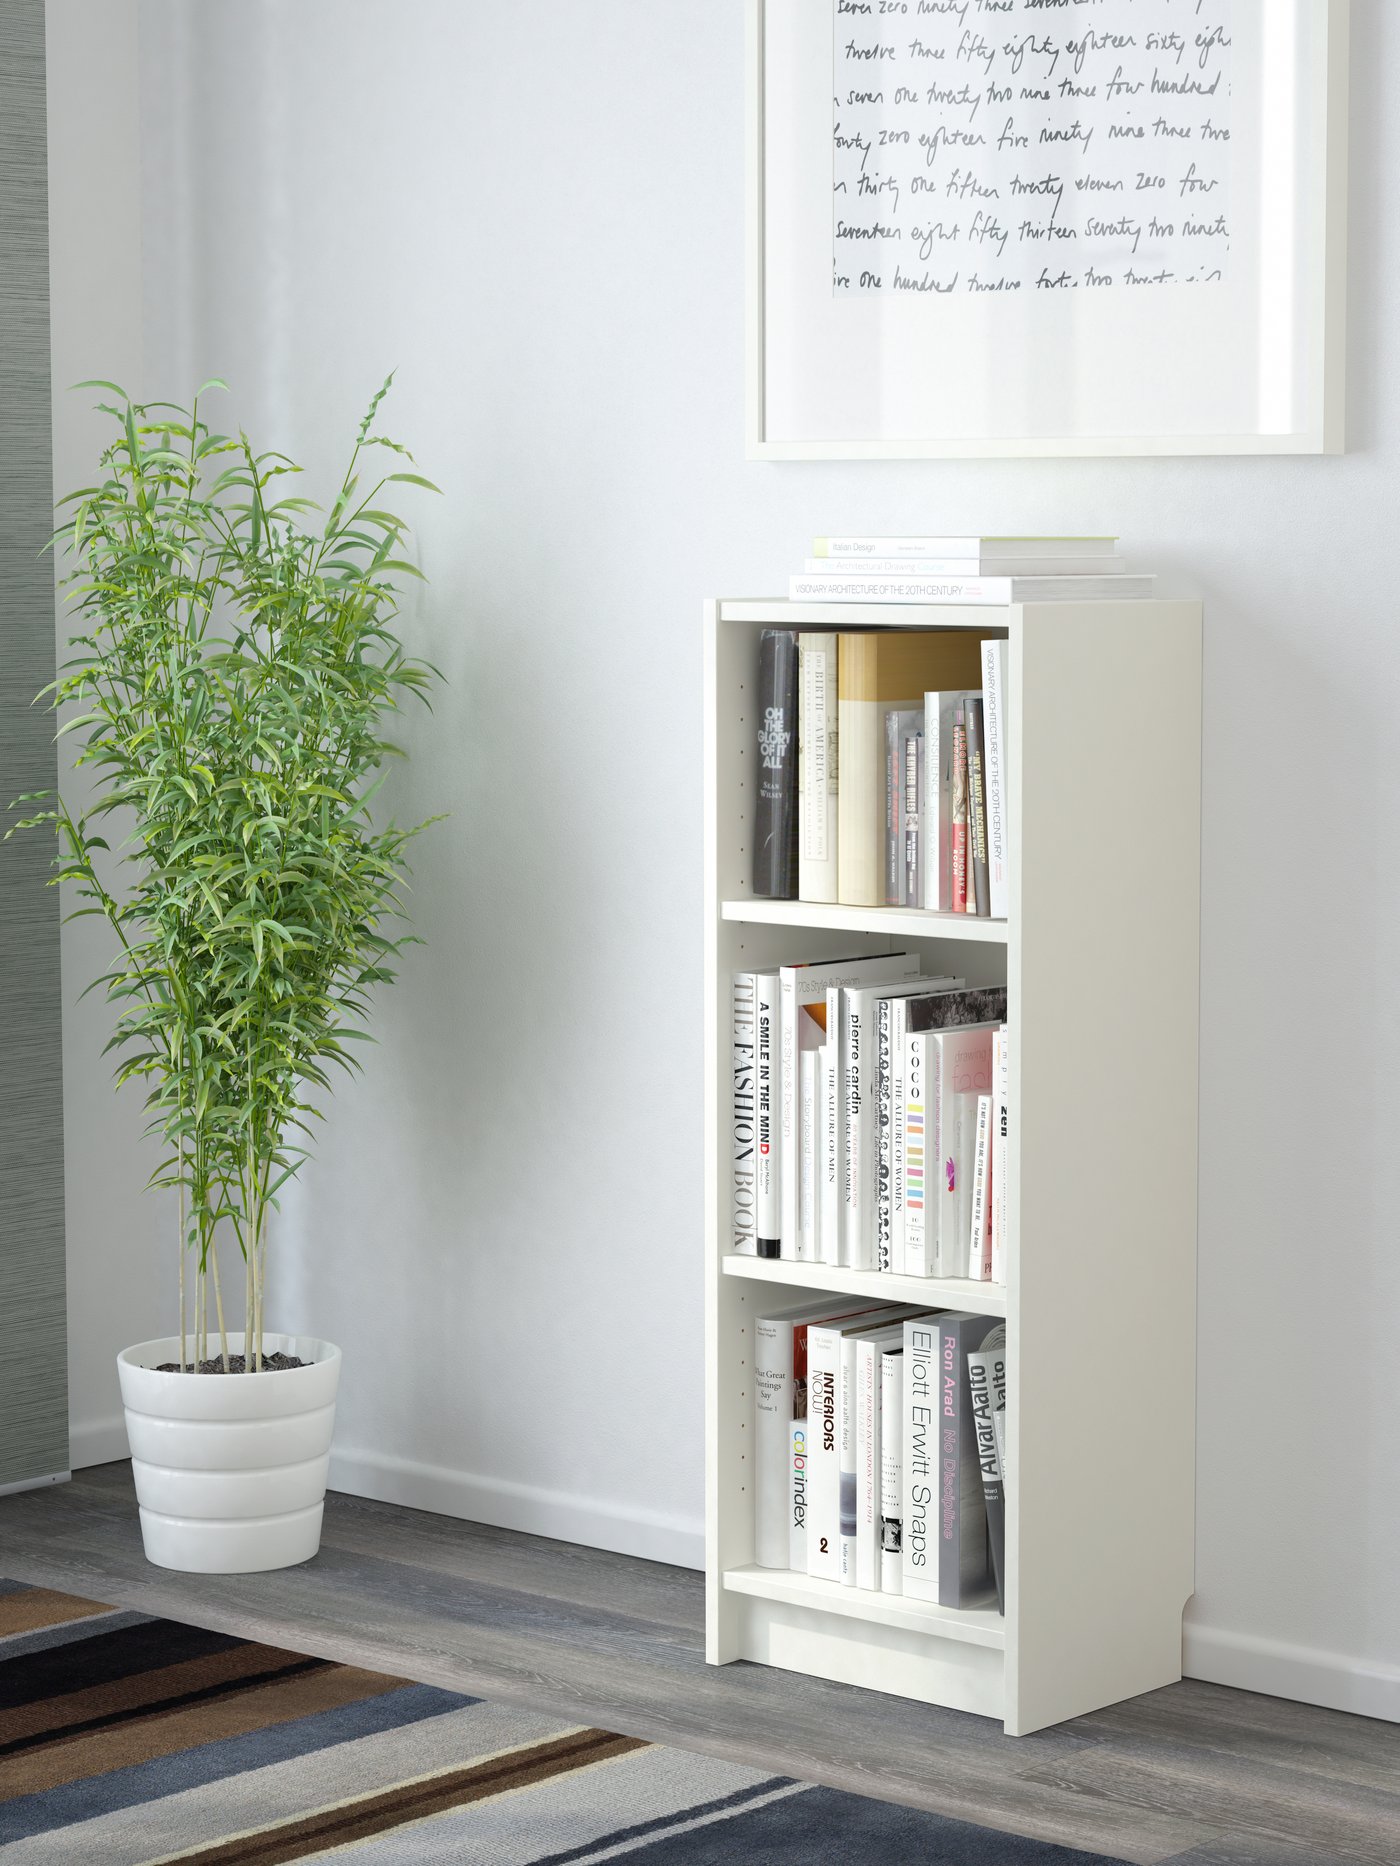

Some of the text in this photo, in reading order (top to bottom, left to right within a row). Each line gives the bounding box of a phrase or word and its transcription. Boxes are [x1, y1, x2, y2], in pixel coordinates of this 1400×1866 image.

[845, 23, 1232, 77] twelve three fifty eighty eighteen sixty eigh
[847, 90, 883, 105] seven
[894, 87, 919, 105] one
[926, 81, 981, 123] twenty
[986, 80, 1013, 105] two
[1020, 76, 1051, 101] nine
[1057, 77, 1096, 98] three
[1106, 65, 1145, 101] four
[1150, 67, 1222, 96] hundred
[879, 111, 1192, 167] zero eighteen five ninety nine three
[856, 172, 899, 214] thirty
[911, 176, 936, 194] one
[946, 168, 1000, 200] fifteen
[1009, 173, 1064, 219] twenty
[1074, 174, 1124, 191] eleven
[1136, 172, 1166, 190] zero
[1179, 162, 1219, 198] four
[910, 221, 960, 261] eight
[968, 210, 1009, 258] fifty
[1018, 220, 1077, 242] thirteen
[1148, 216, 1174, 238] two
[859, 270, 883, 289] one
[893, 265, 959, 293] hundred
[1084, 266, 1113, 287] two
[832, 543, 876, 553] Italian Design
[884, 561, 916, 573] Drawing
[795, 584, 827, 594] VISIONARY
[828, 584, 879, 595] ARCHITECTURE
[879, 585, 889, 594] OF
[890, 585, 904, 595] THE
[905, 585, 926, 596] 20TH
[926, 586, 963, 597] CENTURY
[986, 648, 996, 691] VISIONARY
[764, 719, 785, 732] THE
[765, 707, 784, 720] OH
[815, 670, 825, 783] BIRTH AMERICA
[988, 691, 998, 756] ARCHITECTURE
[757, 730, 791, 745] GLORY
[760, 743, 787, 757] OF IT
[930, 717, 940, 798] CONSILIENCE
[762, 755, 783, 769] ALL
[907, 741, 916, 813] THE KHYBER RIFLES
[990, 756, 998, 769] OF
[991, 769, 999, 788] THE
[974, 773, 983, 804] BRAVE
[992, 788, 1000, 815] 20TH
[959, 831, 966, 843] UP
[959, 845, 966, 857] IN
[993, 814, 1002, 861] CENTURY
[760, 1002, 770, 1155] A SMILE IN THE MIND
[851, 1014, 862, 1114] pierre cardin
[911, 1041, 920, 1099] COCO
[733, 977, 756, 1248] THE FASHION BOOK
[804, 1097, 813, 1154] Storyboard
[1000, 1105, 1008, 1138] zen
[829, 1139, 835, 1156] OF
[895, 1076, 903, 1212] THE ALLURE OF WOMEN
[760, 1390, 772, 1401] Say
[766, 1370, 786, 1380] Great
[812, 1369, 823, 1415] NOW!
[823, 1371, 835, 1452] INTERIORS
[970, 1364, 999, 1476] Alvar Aalto
[842, 1427, 850, 1451] design
[866, 1429, 873, 1440] IN
[907, 1330, 932, 1567] Elliott Erwitt Snaps
[941, 1336, 956, 1540] Ron Arad No Discipline
[794, 1430, 808, 1529] colorindex
[820, 1537, 829, 1554] 2
